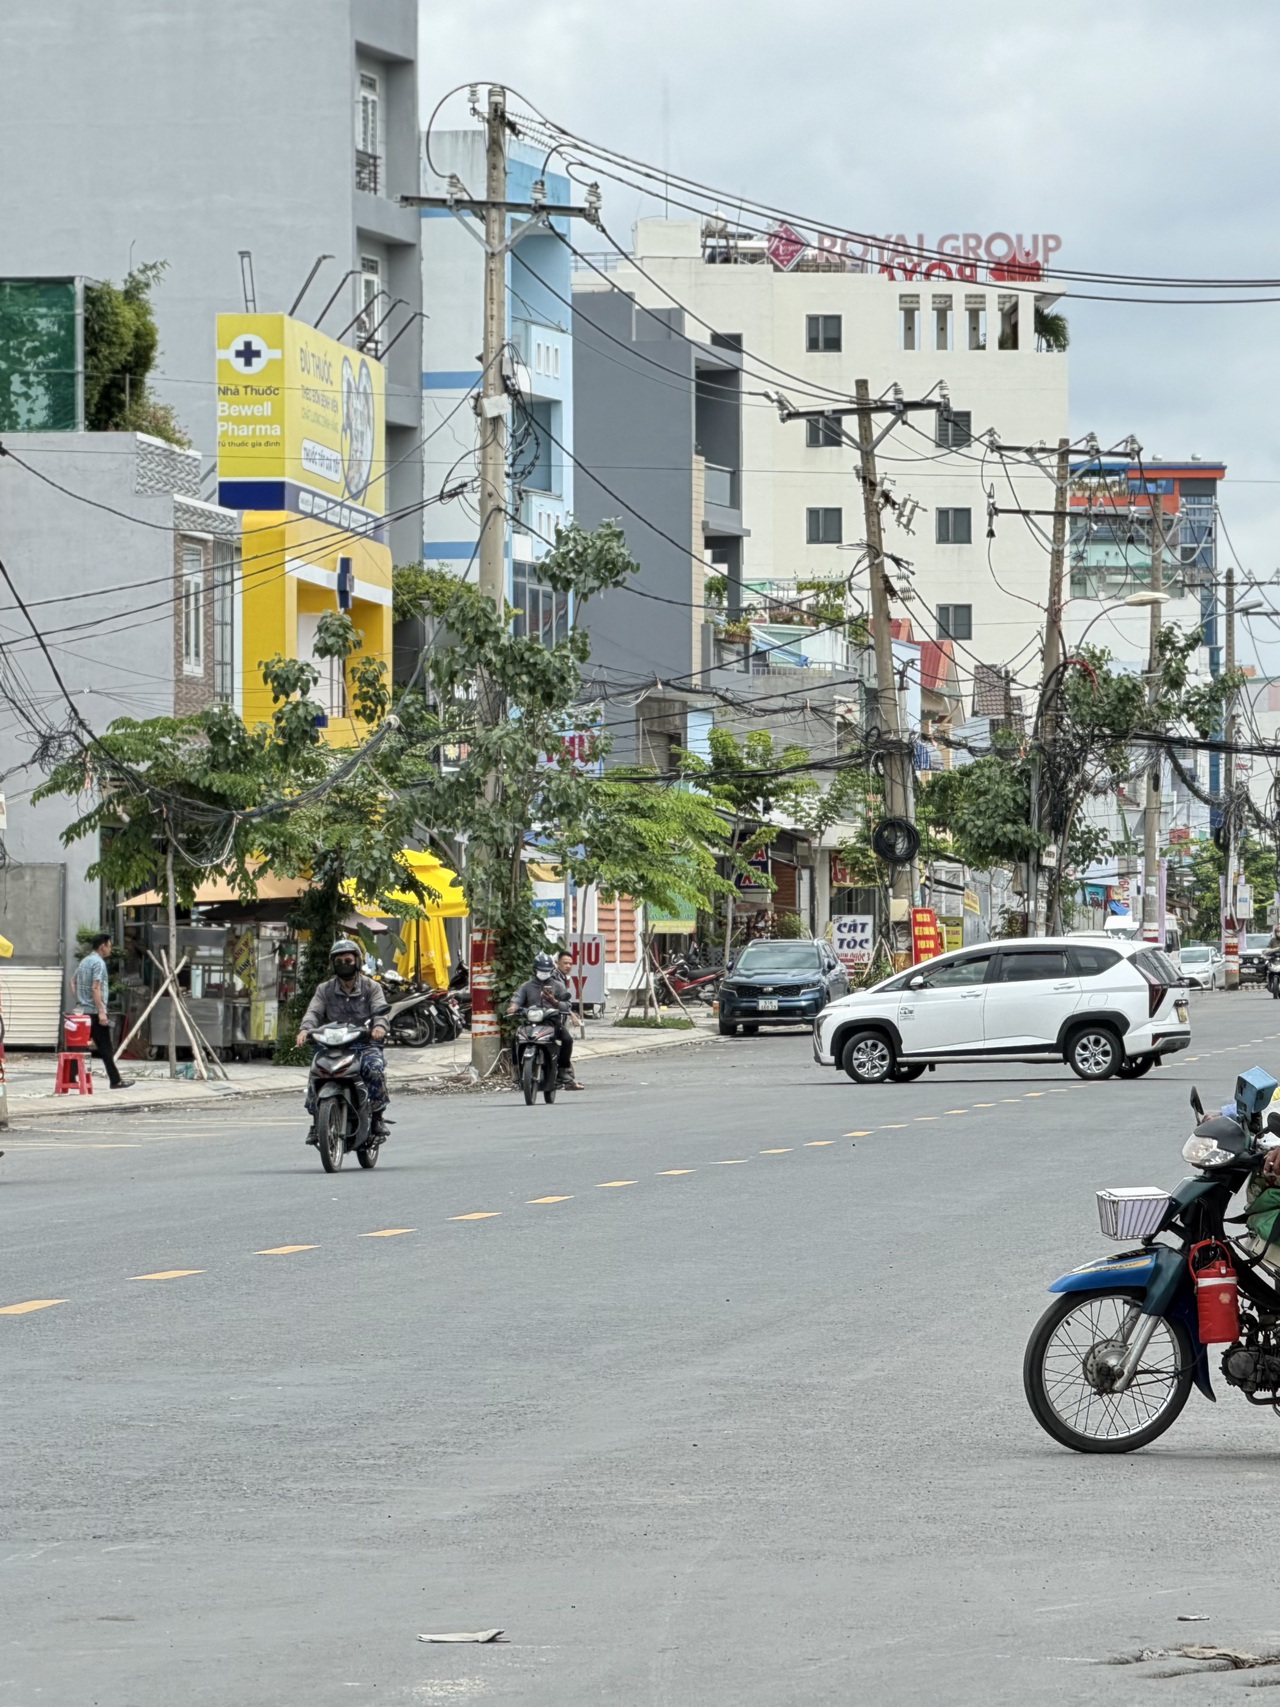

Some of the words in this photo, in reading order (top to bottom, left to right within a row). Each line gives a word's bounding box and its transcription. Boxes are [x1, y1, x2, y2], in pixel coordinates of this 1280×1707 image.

[816, 232, 926, 265] ROYAL
[936, 231, 1063, 264] GROUP
[218, 385, 240, 396] Nhà
[243, 385, 280, 396] Thuốc
[217, 401, 272, 416] Bewell
[217, 421, 281, 436] Pharma
[837, 918, 869, 934] CẮT
[837, 936, 870, 950] TÓC
